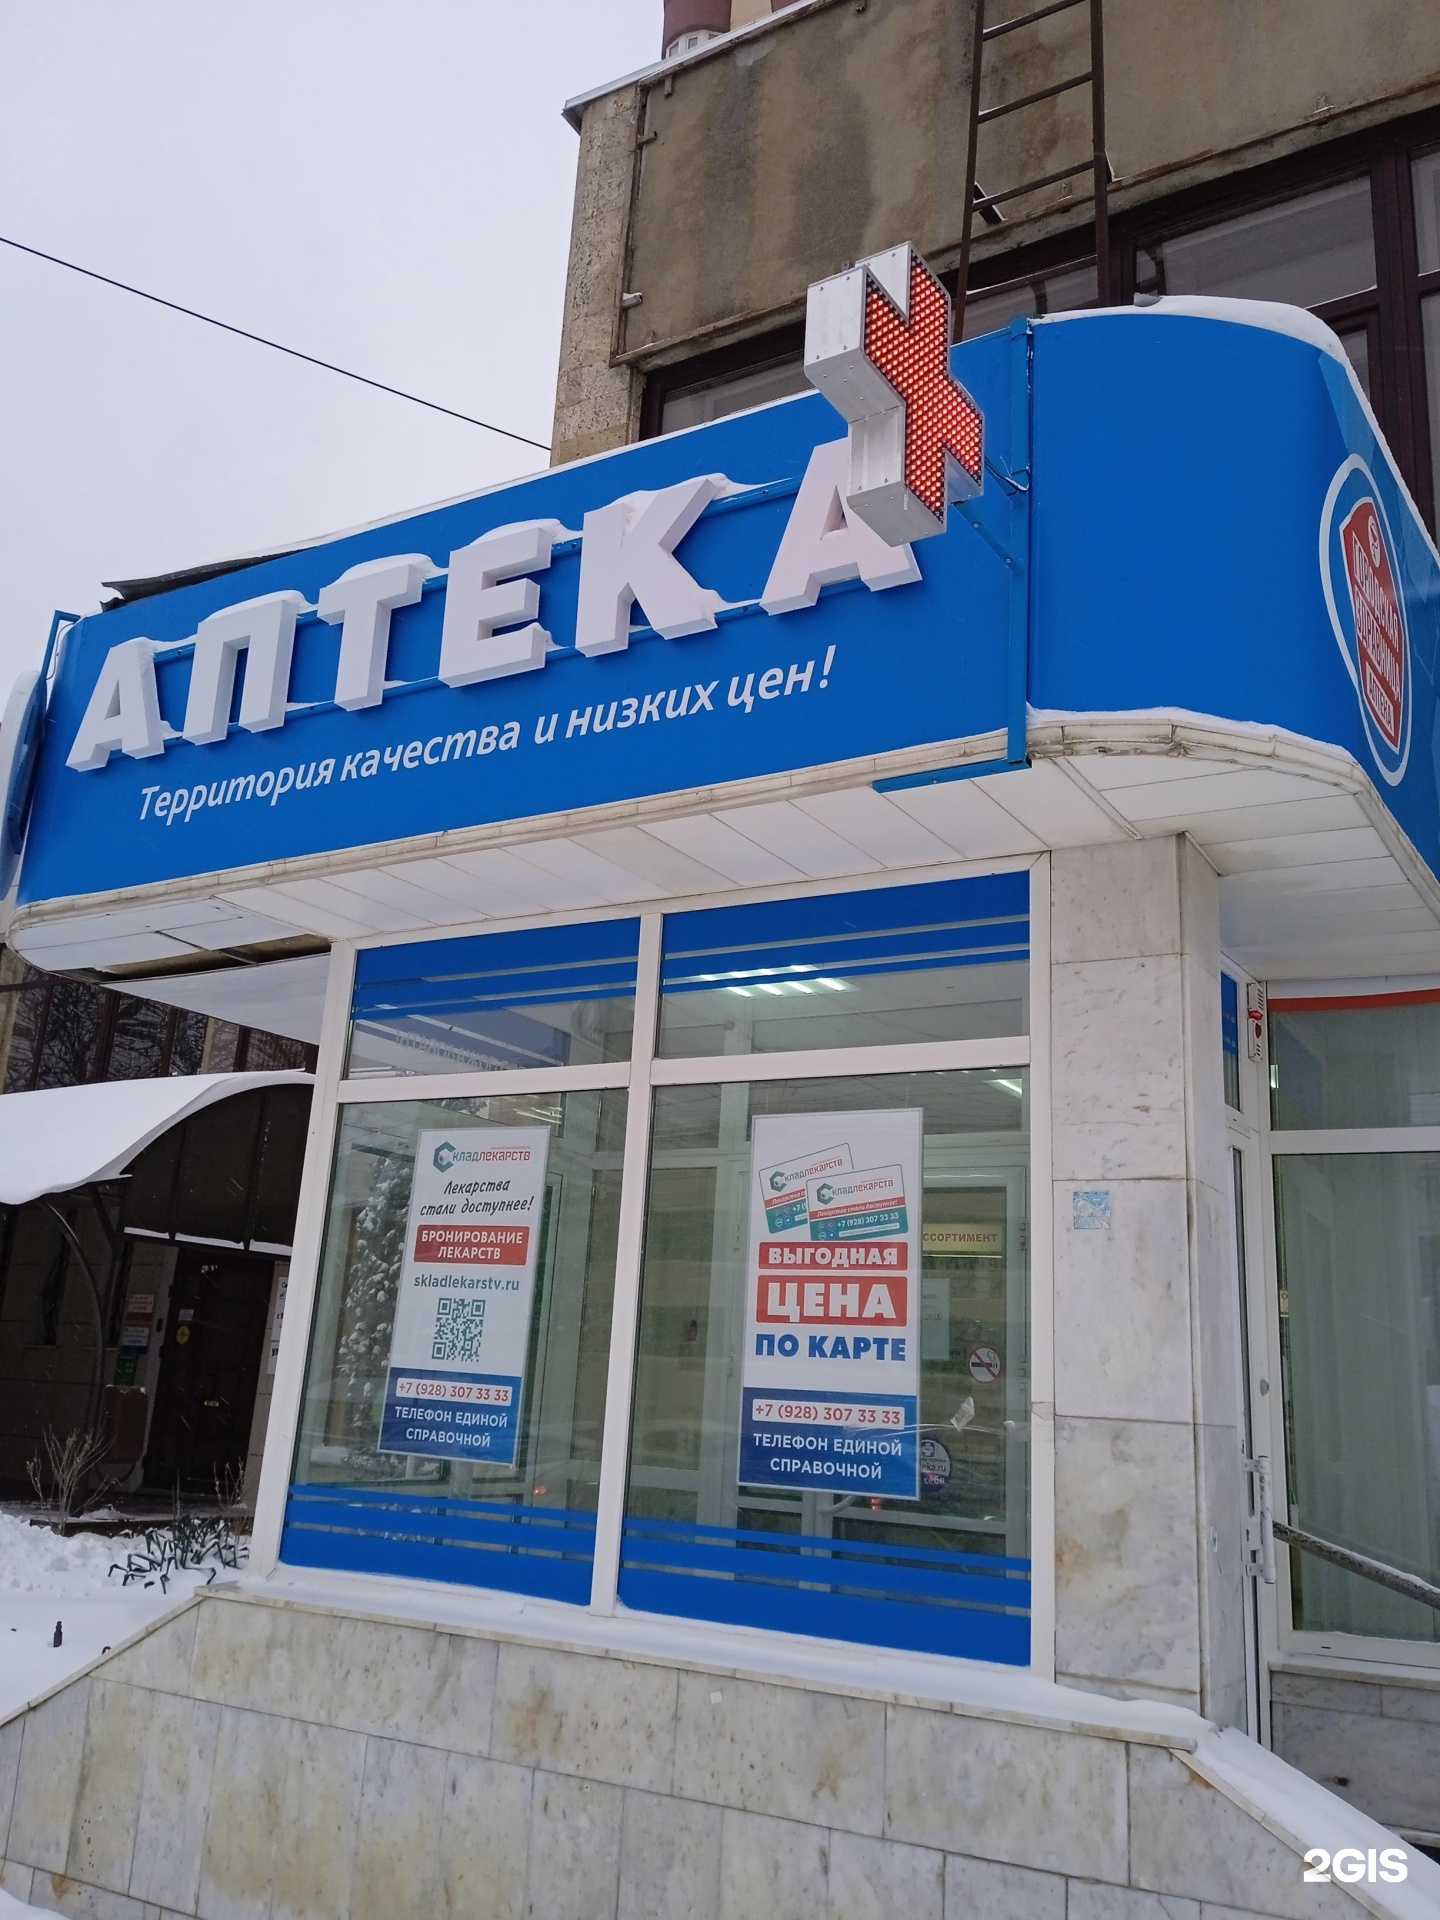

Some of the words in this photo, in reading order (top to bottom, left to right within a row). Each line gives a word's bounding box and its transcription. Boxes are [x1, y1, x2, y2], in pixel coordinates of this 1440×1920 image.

[66, 437, 922, 772] АПТЕКА
[139, 758, 336, 826] Территория
[340, 720, 520, 782] качества
[534, 713, 559, 745] и
[565, 679, 719, 738] низких
[727, 644, 836, 713] цен!
[443, 1179, 511, 1196] Лекарства
[420, 1203, 457, 1217] стали
[461, 1195, 535, 1217] доступнее!
[421, 1230, 524, 1244] БРОНИРОВАНИЕ
[437, 1246, 501, 1260] ЛЕКАРСТВ
[768, 1247, 898, 1268] ВЫГОДНАЯ
[414, 1274, 520, 1291] skladlekarstv.ru
[767, 1282, 897, 1323] ЦЕНА
[755, 1333, 800, 1358] ПО
[808, 1336, 906, 1361] КАРТЕ
[399, 1382, 412, 1393] +7
[415, 1383, 447, 1398] (928)
[450, 1387, 473, 1399] 307
[476, 1387, 491, 1400] 33
[494, 1389, 509, 1402] 33
[395, 1406, 452, 1423] ТЕЛЕФОН
[455, 1412, 508, 1428] ЕДИНОЙ
[755, 1404, 773, 1416] +7
[778, 1405, 818, 1421] (928)
[823, 1407, 852, 1421] 307
[858, 1409, 876, 1423] 33
[882, 1410, 900, 1424] 33
[406, 1428, 491, 1447] СПРАВОЧНОЙ
[753, 1433, 828, 1451] ТЕЛЕФОН
[833, 1439, 902, 1457] ЕДИНОЙ
[770, 1458, 882, 1480] СПРАВОЧНОЙ
